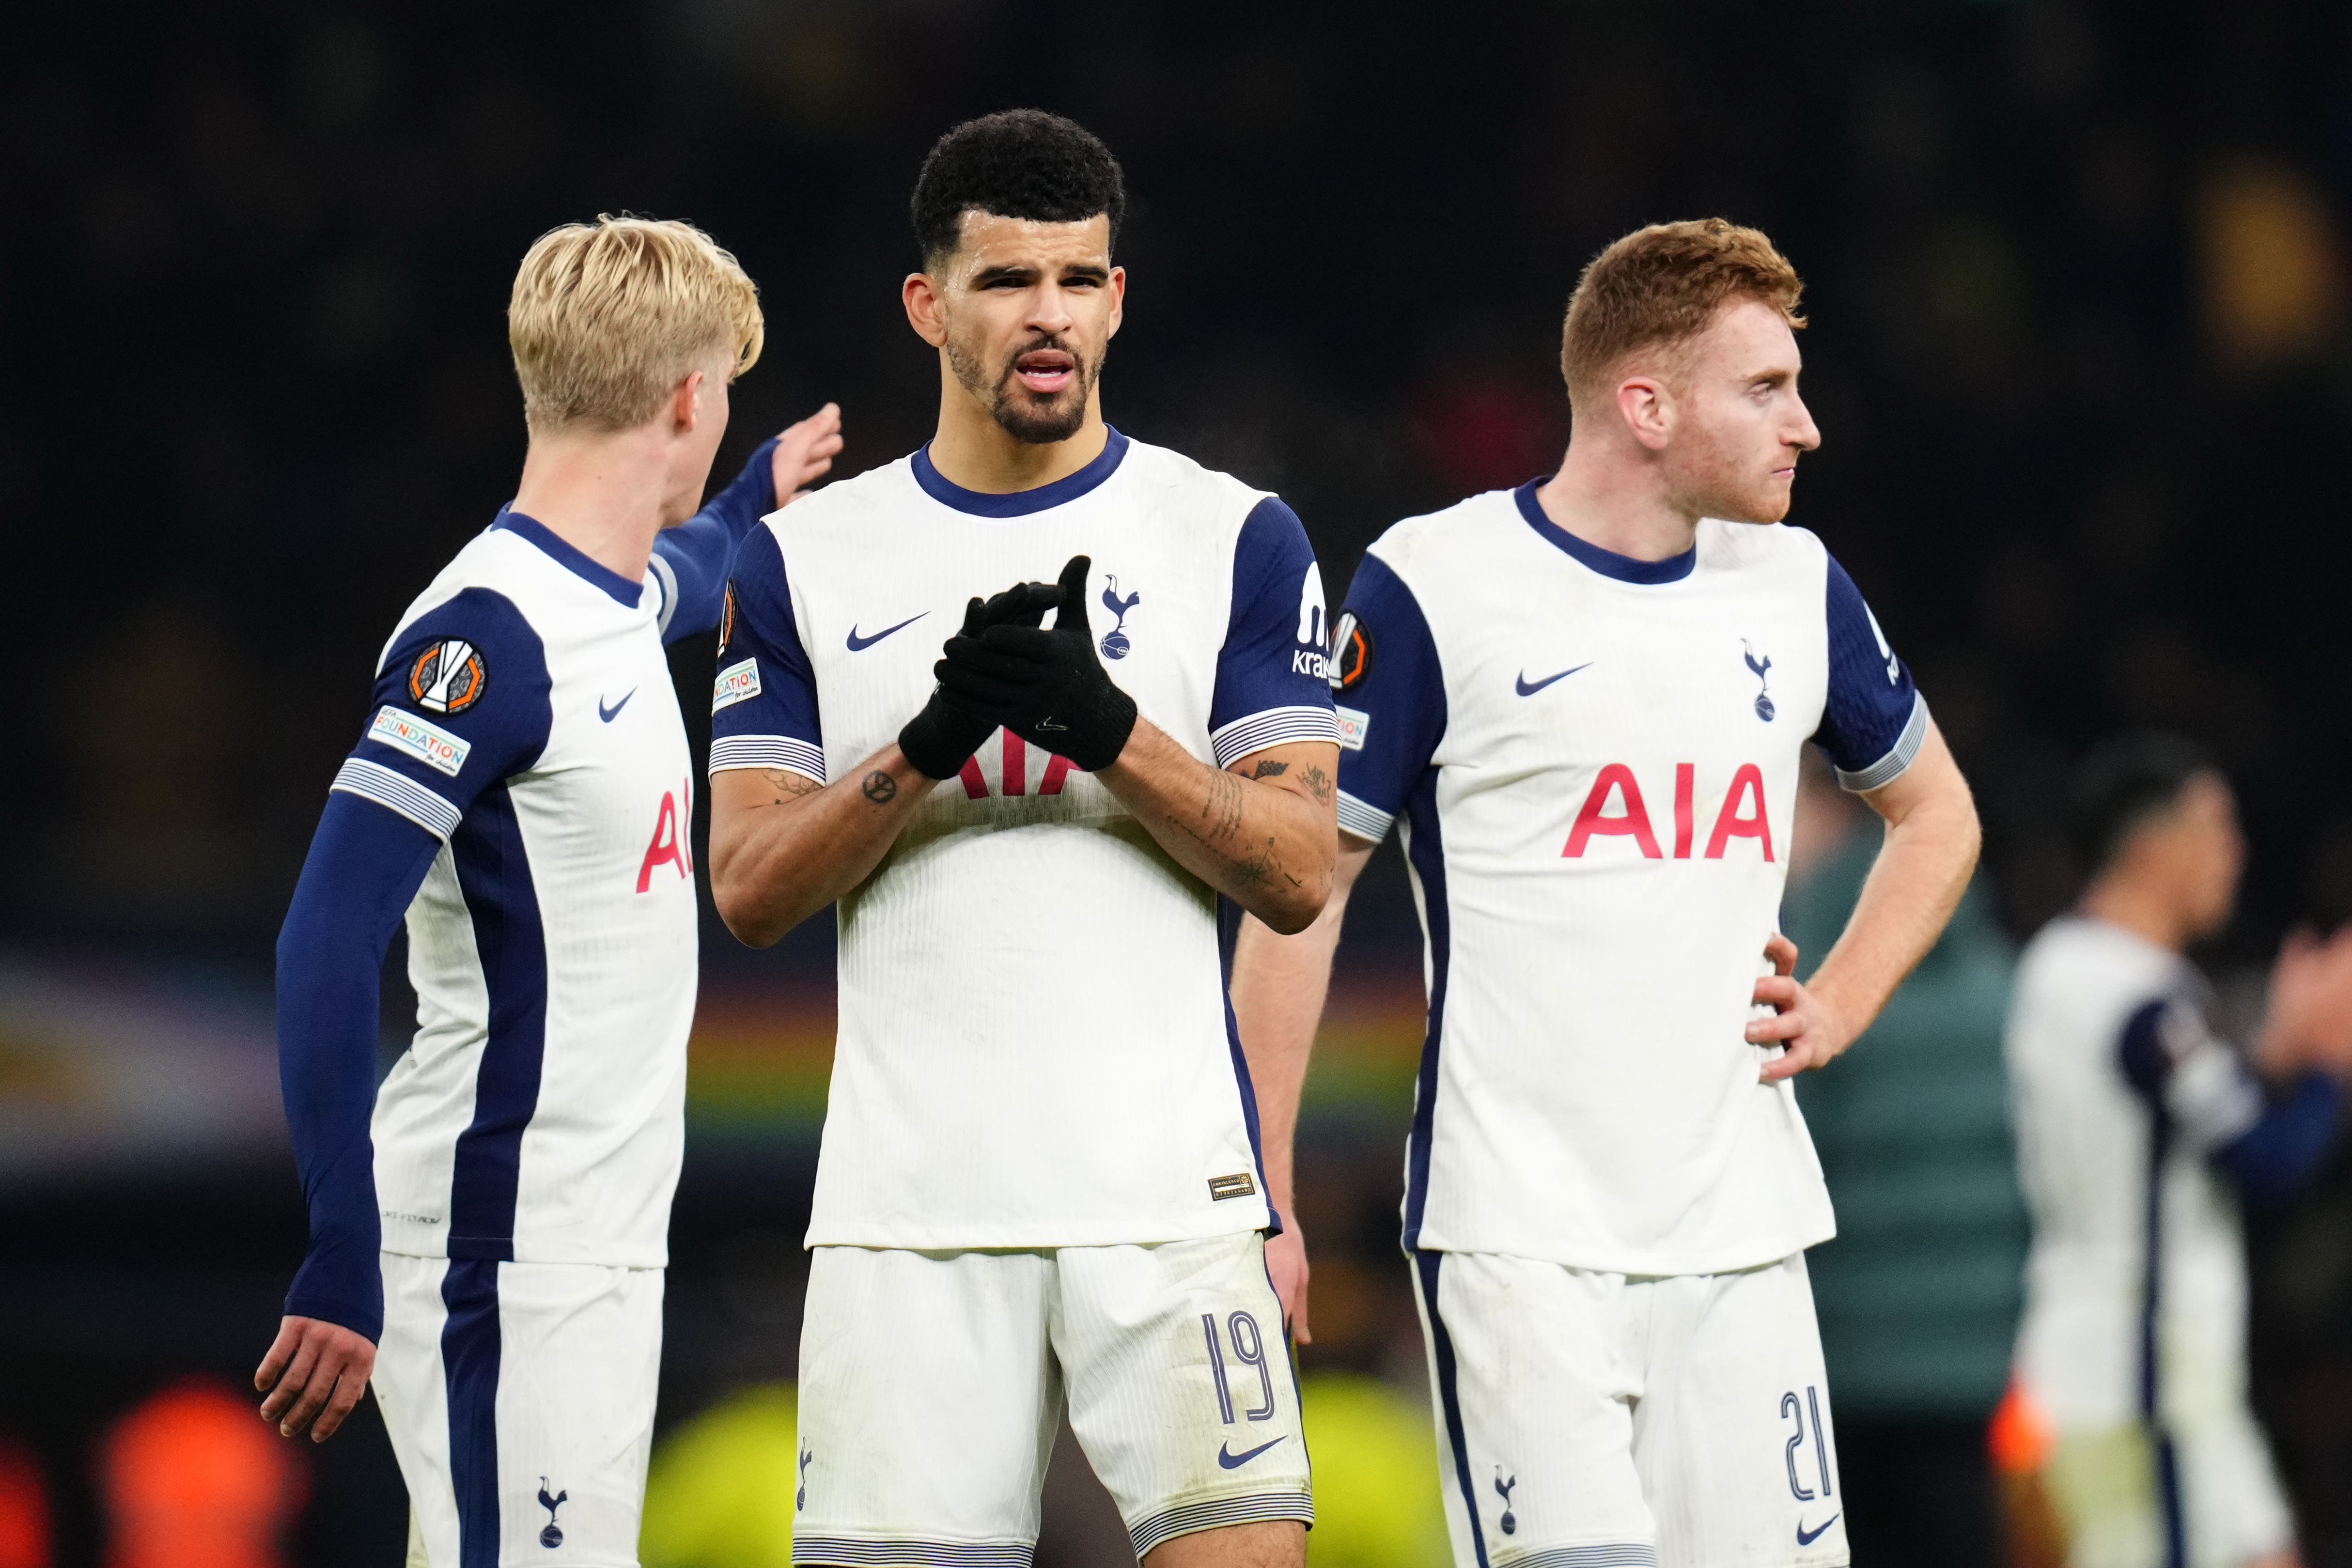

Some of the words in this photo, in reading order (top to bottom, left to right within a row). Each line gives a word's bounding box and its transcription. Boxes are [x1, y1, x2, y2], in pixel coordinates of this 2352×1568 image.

[381, 707, 396, 717] UEFA
[743, 686, 758, 696] children
[375, 715, 464, 765] FOUNDATION
[1561, 762, 1775, 863] AIA
[1201, 1310, 1275, 1425] 19
[1781, 1386, 1830, 1501] 21
